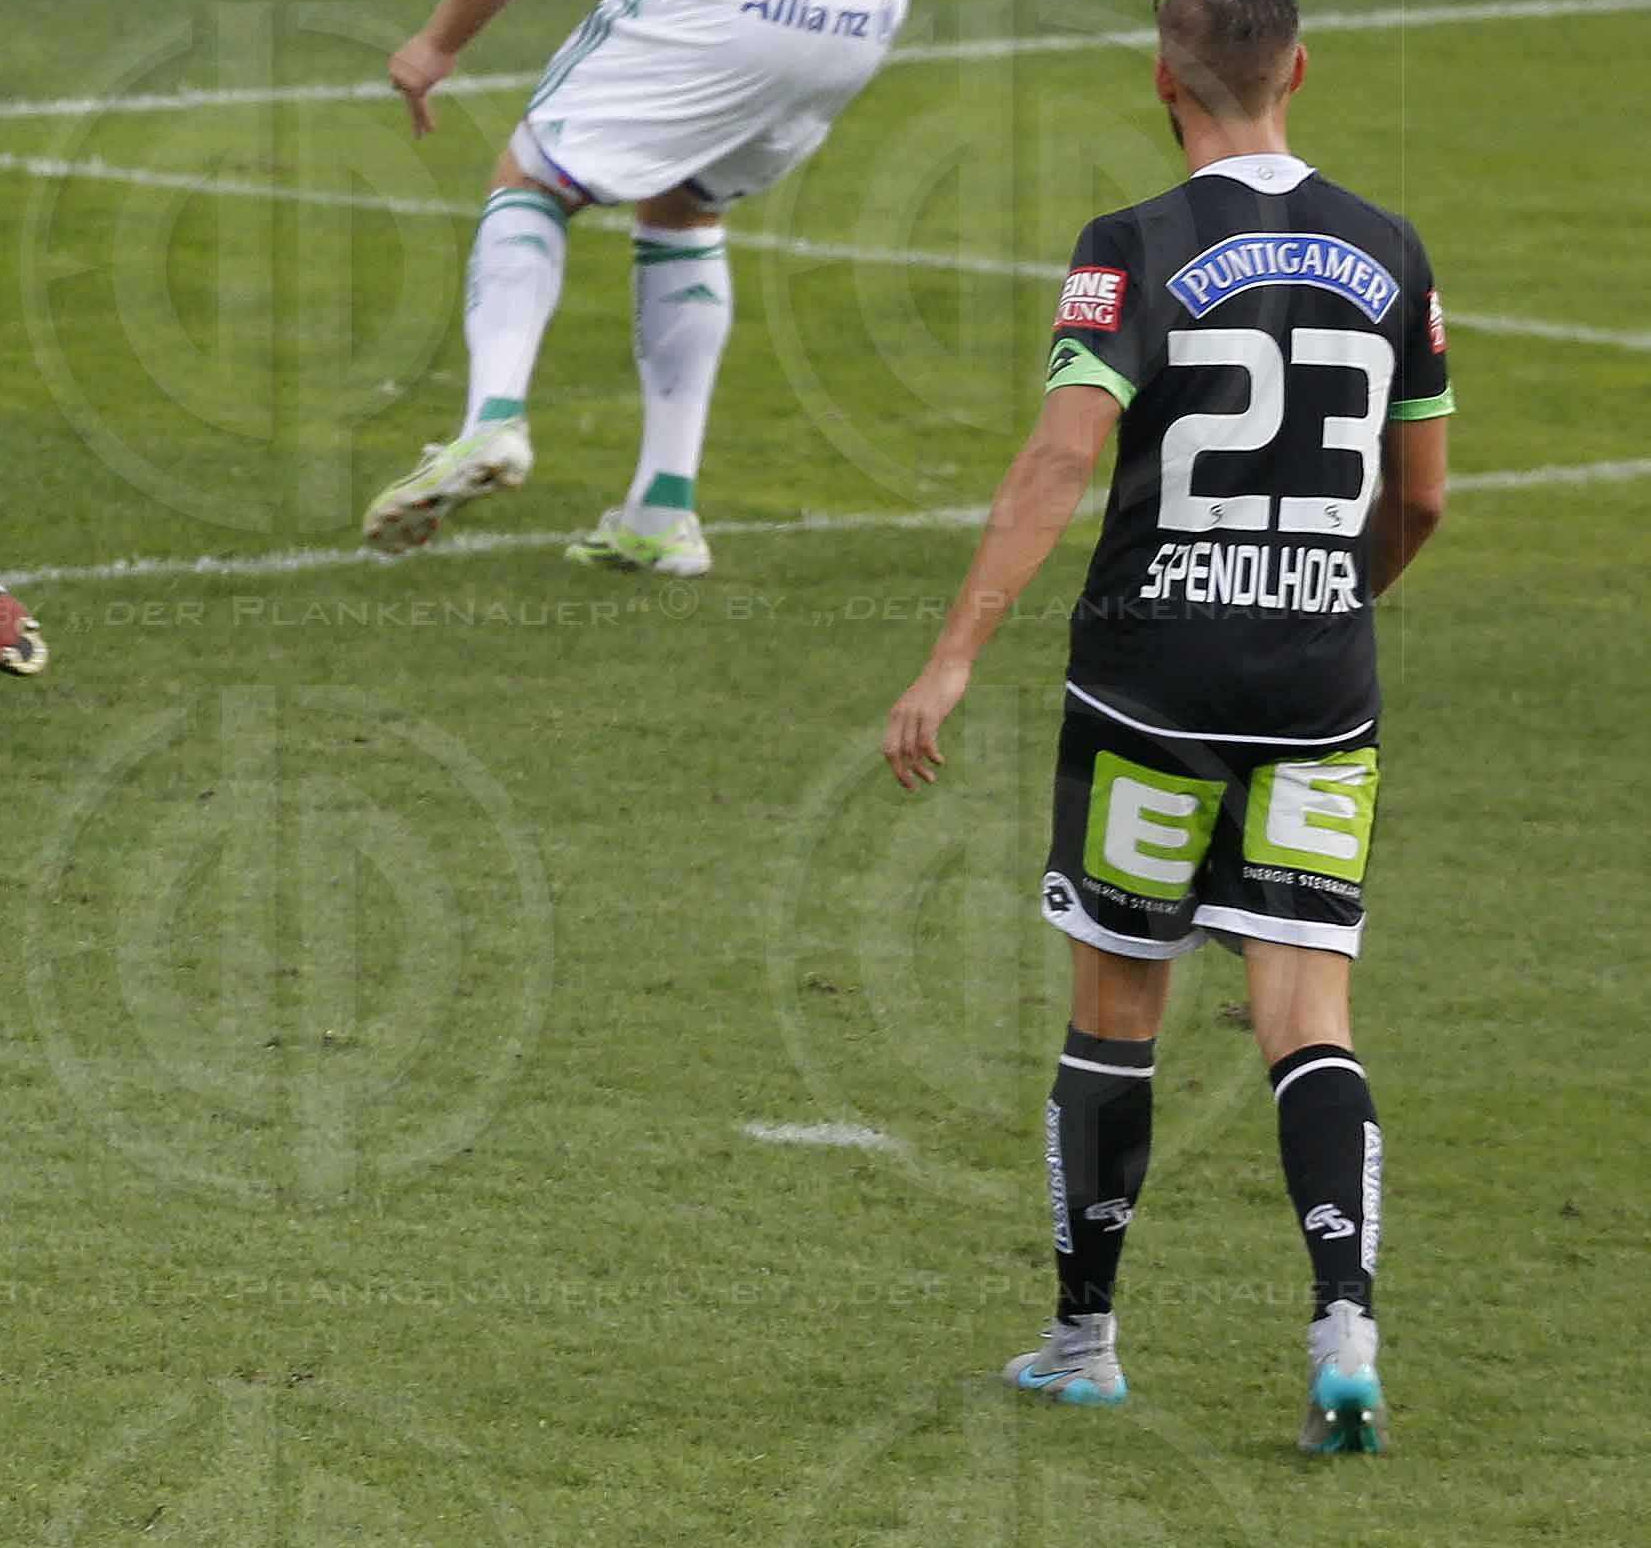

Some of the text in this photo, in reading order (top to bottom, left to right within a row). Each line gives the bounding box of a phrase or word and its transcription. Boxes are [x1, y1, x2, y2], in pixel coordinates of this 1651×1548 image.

[1187, 243, 1387, 312] PUNTIGAMER
[1156, 327, 1396, 538] 23
[1242, 865, 1295, 885] ENERGIE
